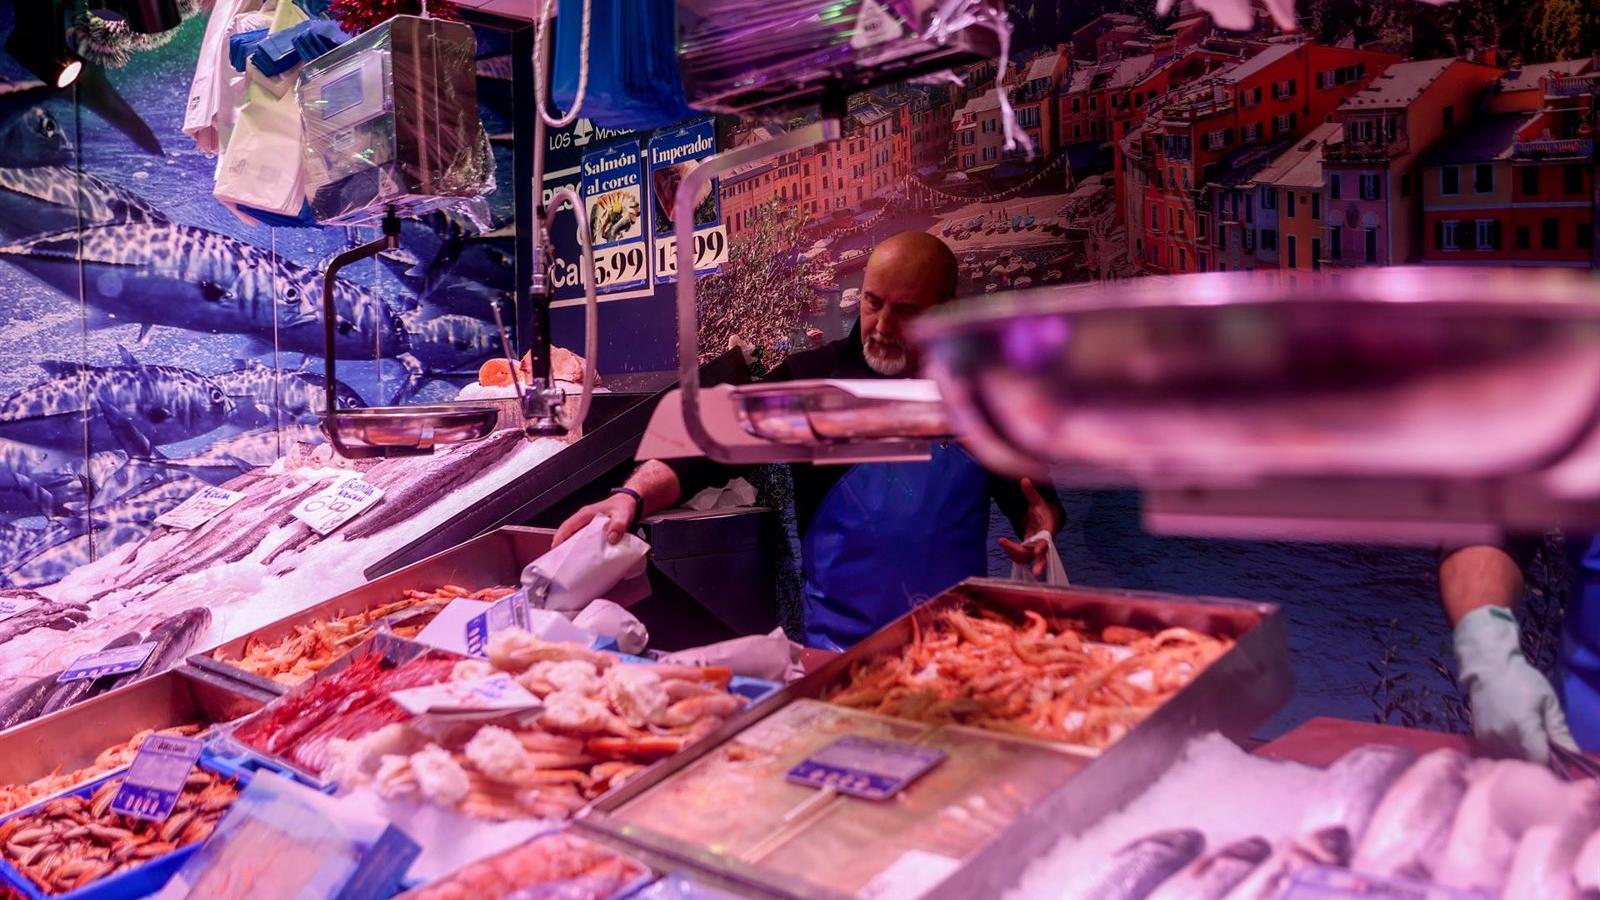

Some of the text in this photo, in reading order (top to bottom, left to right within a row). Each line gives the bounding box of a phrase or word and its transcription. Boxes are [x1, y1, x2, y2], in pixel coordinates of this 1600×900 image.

[549, 131, 571, 151] LOS
[652, 134, 714, 164] Emperador
[584, 151, 637, 177] Salmón
[586, 172, 638, 196] al corte
